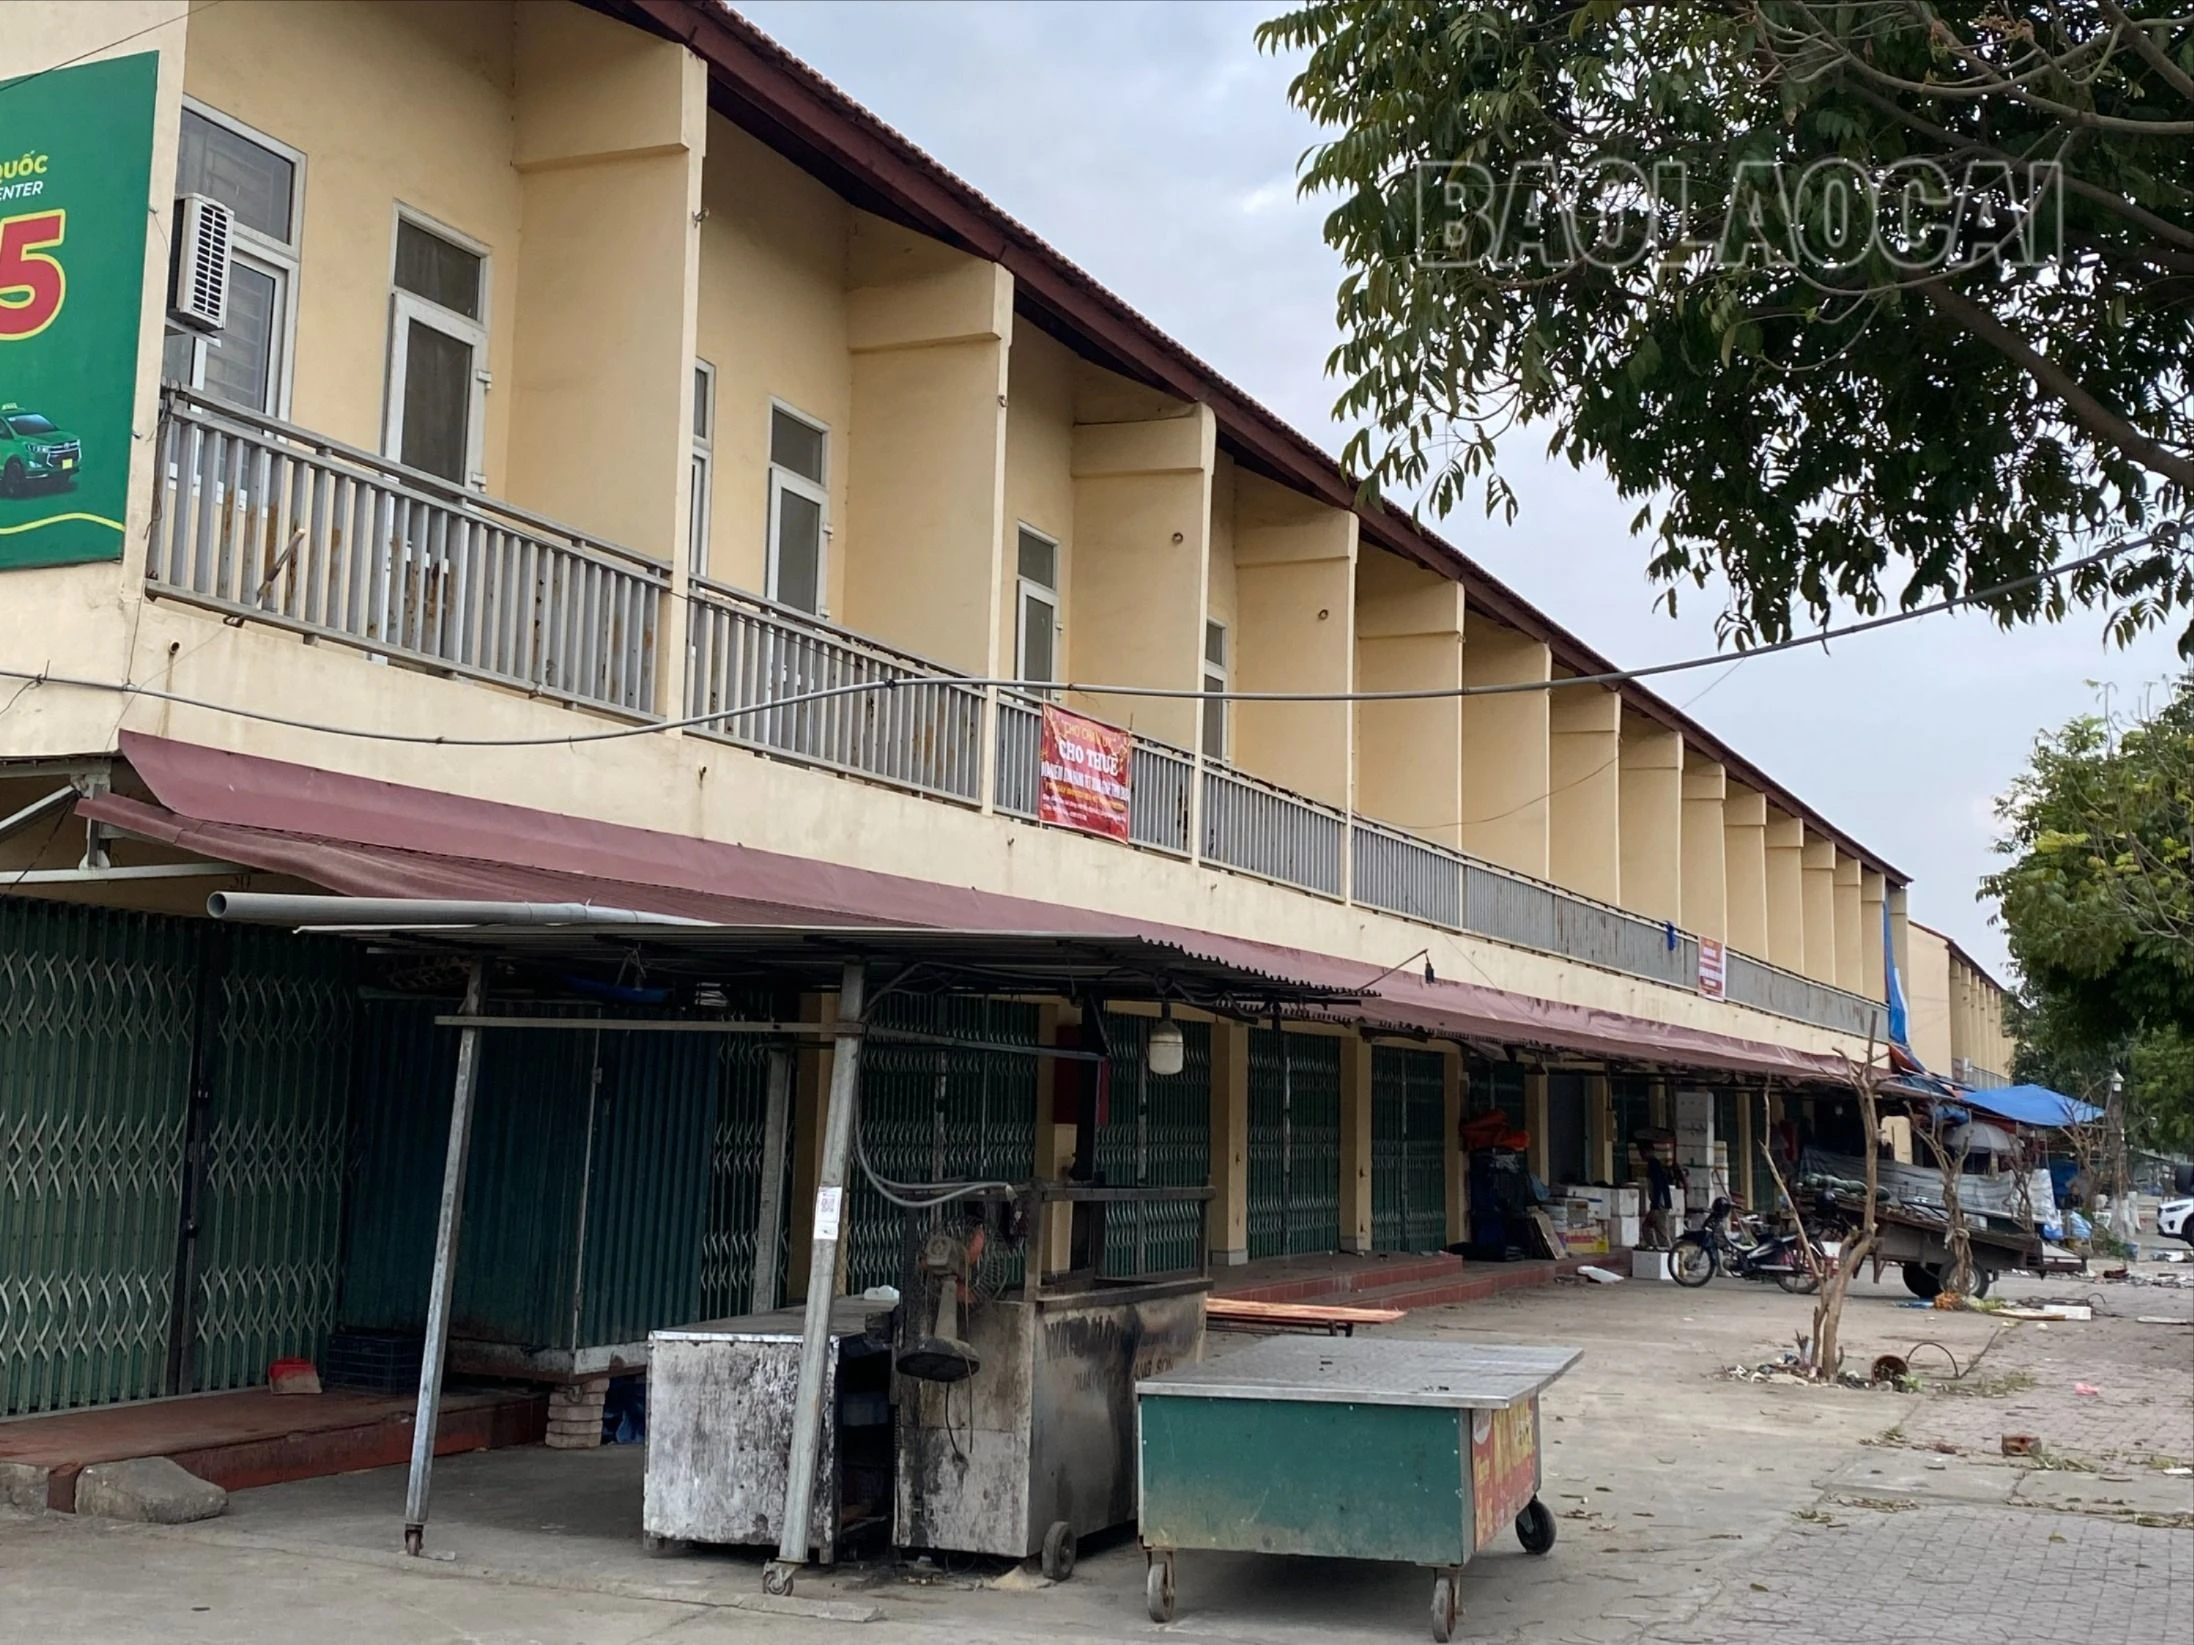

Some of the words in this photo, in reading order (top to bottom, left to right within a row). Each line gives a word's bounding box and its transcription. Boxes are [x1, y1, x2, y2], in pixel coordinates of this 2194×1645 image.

[0, 150, 49, 181] UỐC
[0, 208, 66, 341] 5
[1059, 739, 1084, 764] CHO
[1086, 748, 1118, 776] THUÊ
